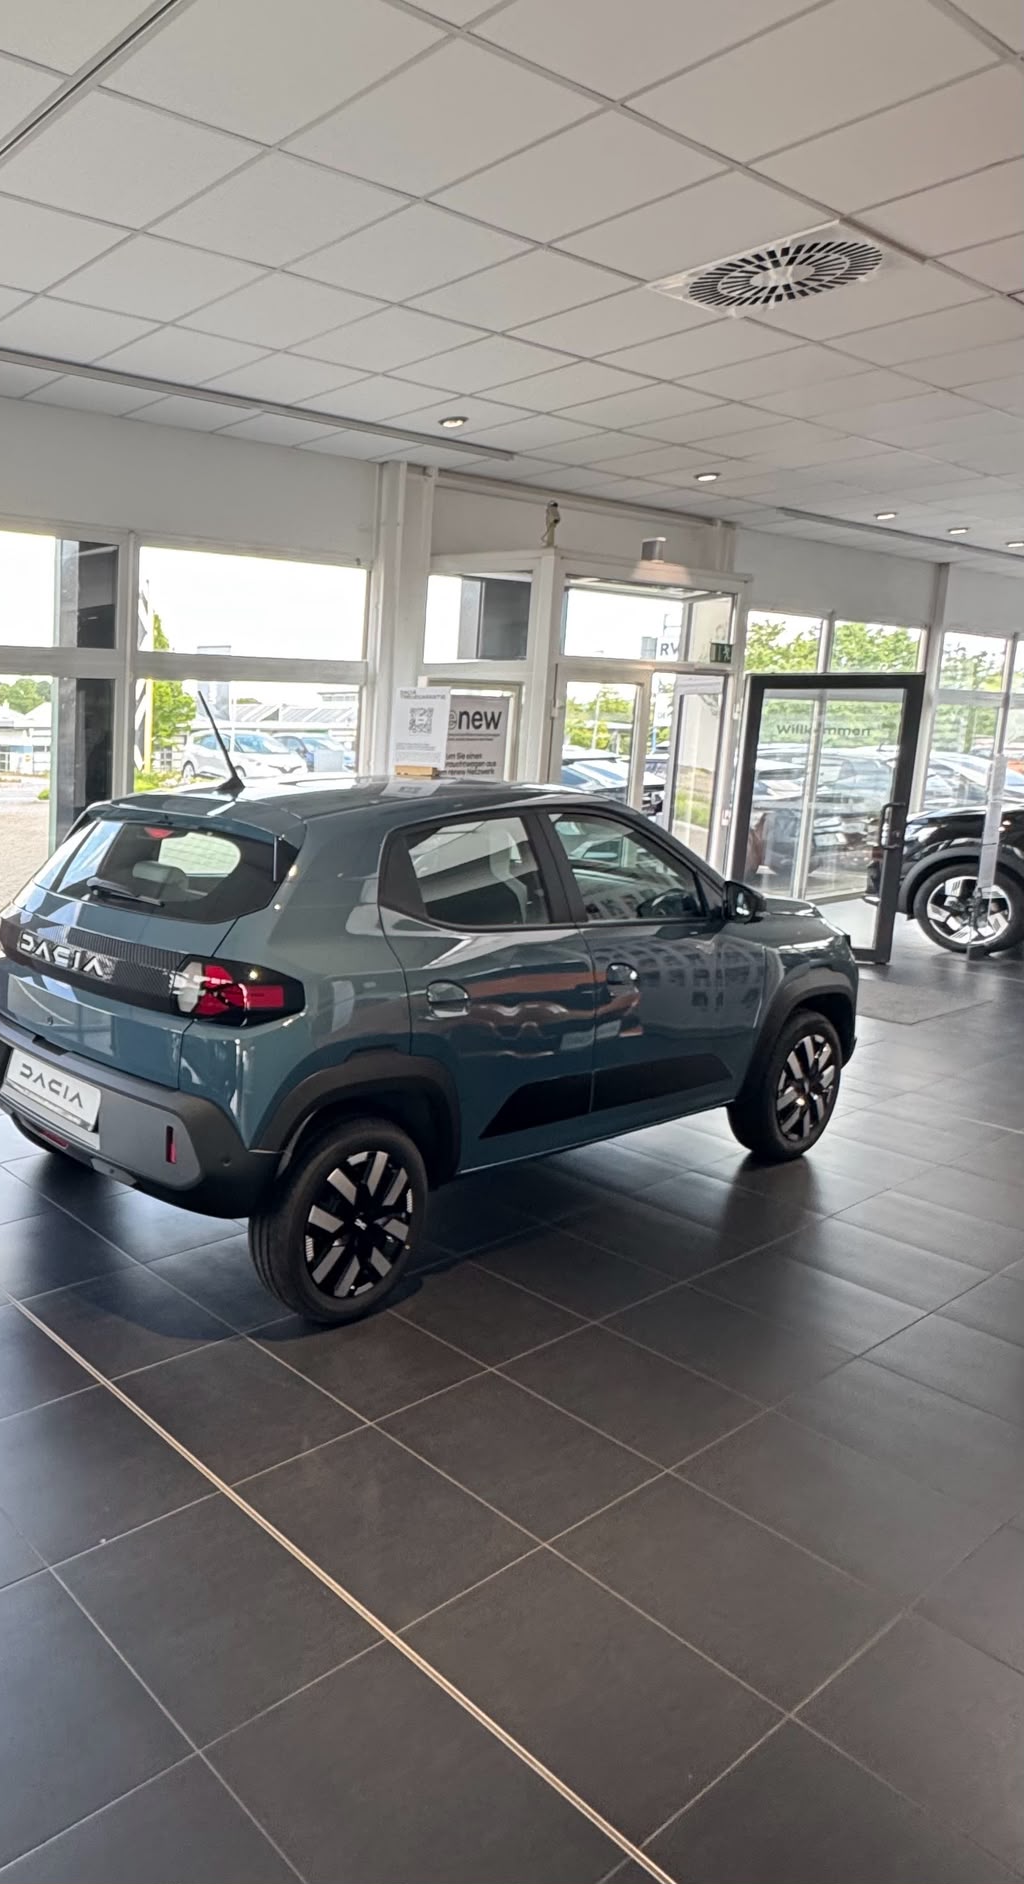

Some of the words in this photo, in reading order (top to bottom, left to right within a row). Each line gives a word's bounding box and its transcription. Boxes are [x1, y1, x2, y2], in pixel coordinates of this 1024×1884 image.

[448, 710, 502, 730] enew
[777, 724, 871, 736] Willkmmen
[19, 932, 104, 978] DACIA
[19, 1063, 84, 1109] DACIA
